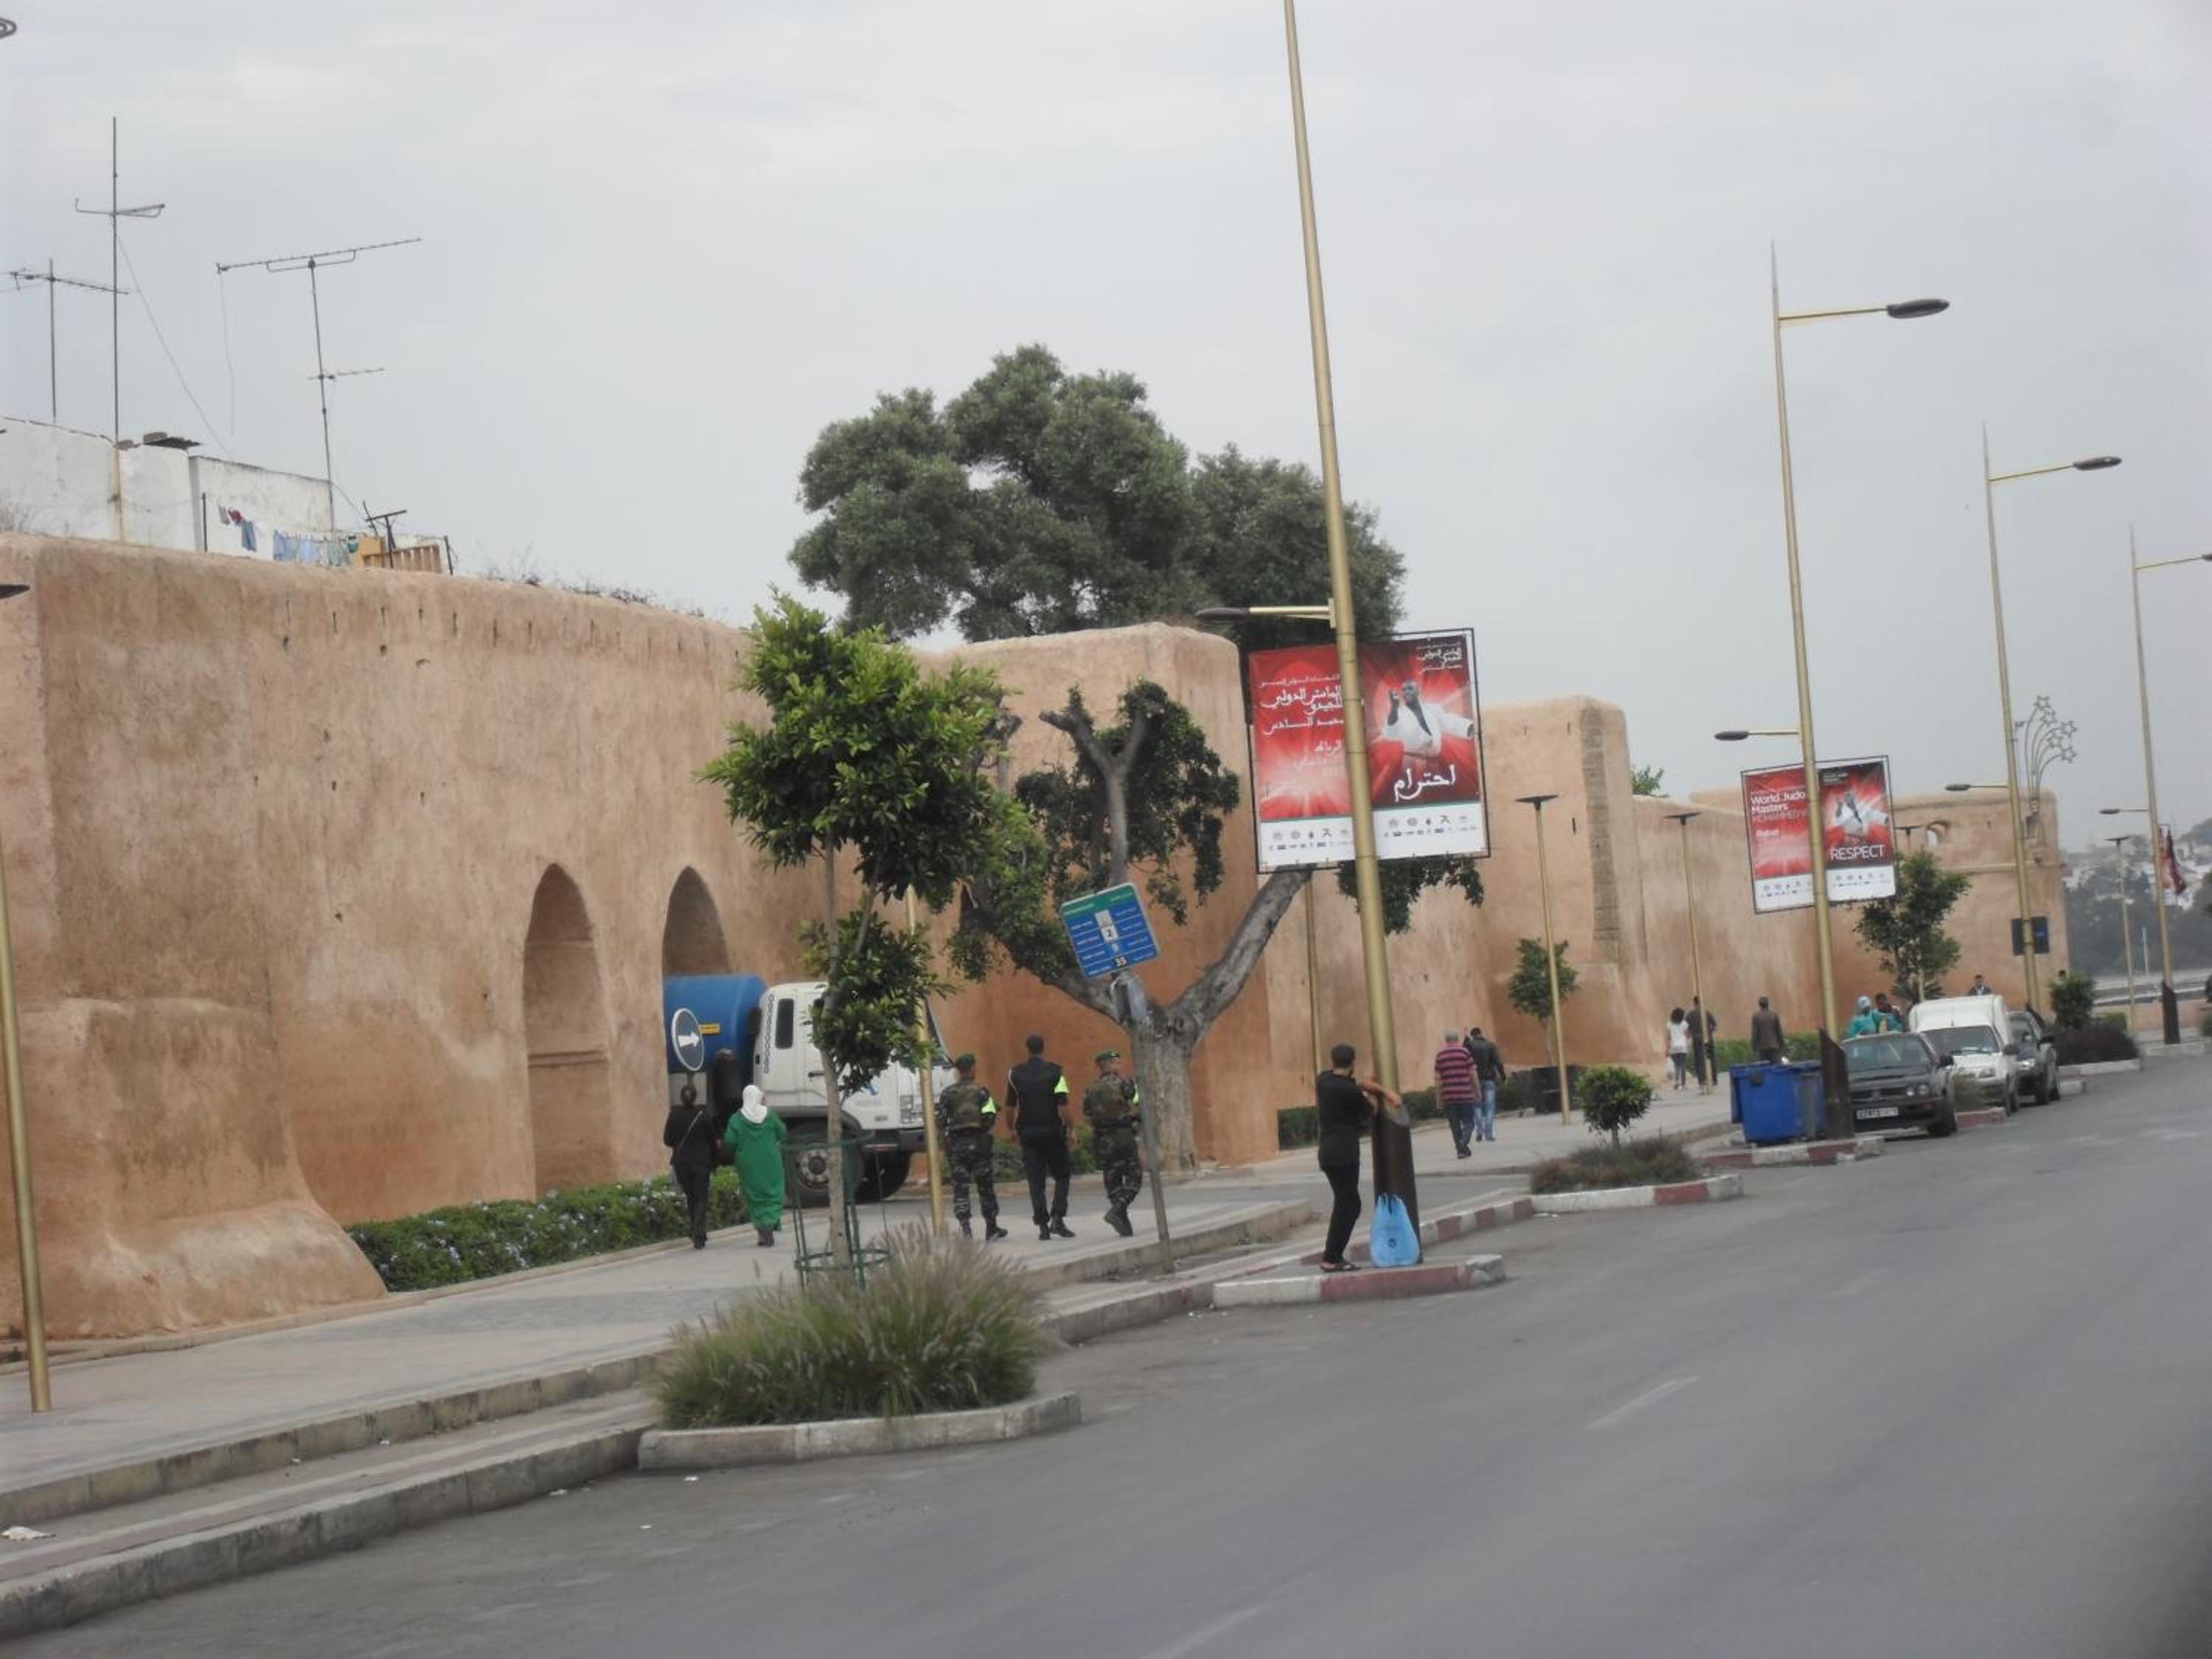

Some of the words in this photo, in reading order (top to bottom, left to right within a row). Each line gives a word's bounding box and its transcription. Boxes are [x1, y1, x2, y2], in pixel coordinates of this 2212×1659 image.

[1394, 763, 1455, 803] احترام
[1750, 791, 1781, 805] World
[1781, 790, 1806, 802] Judo
[1751, 802, 1790, 815] Masters
[1829, 844, 1885, 861] RESPECT
